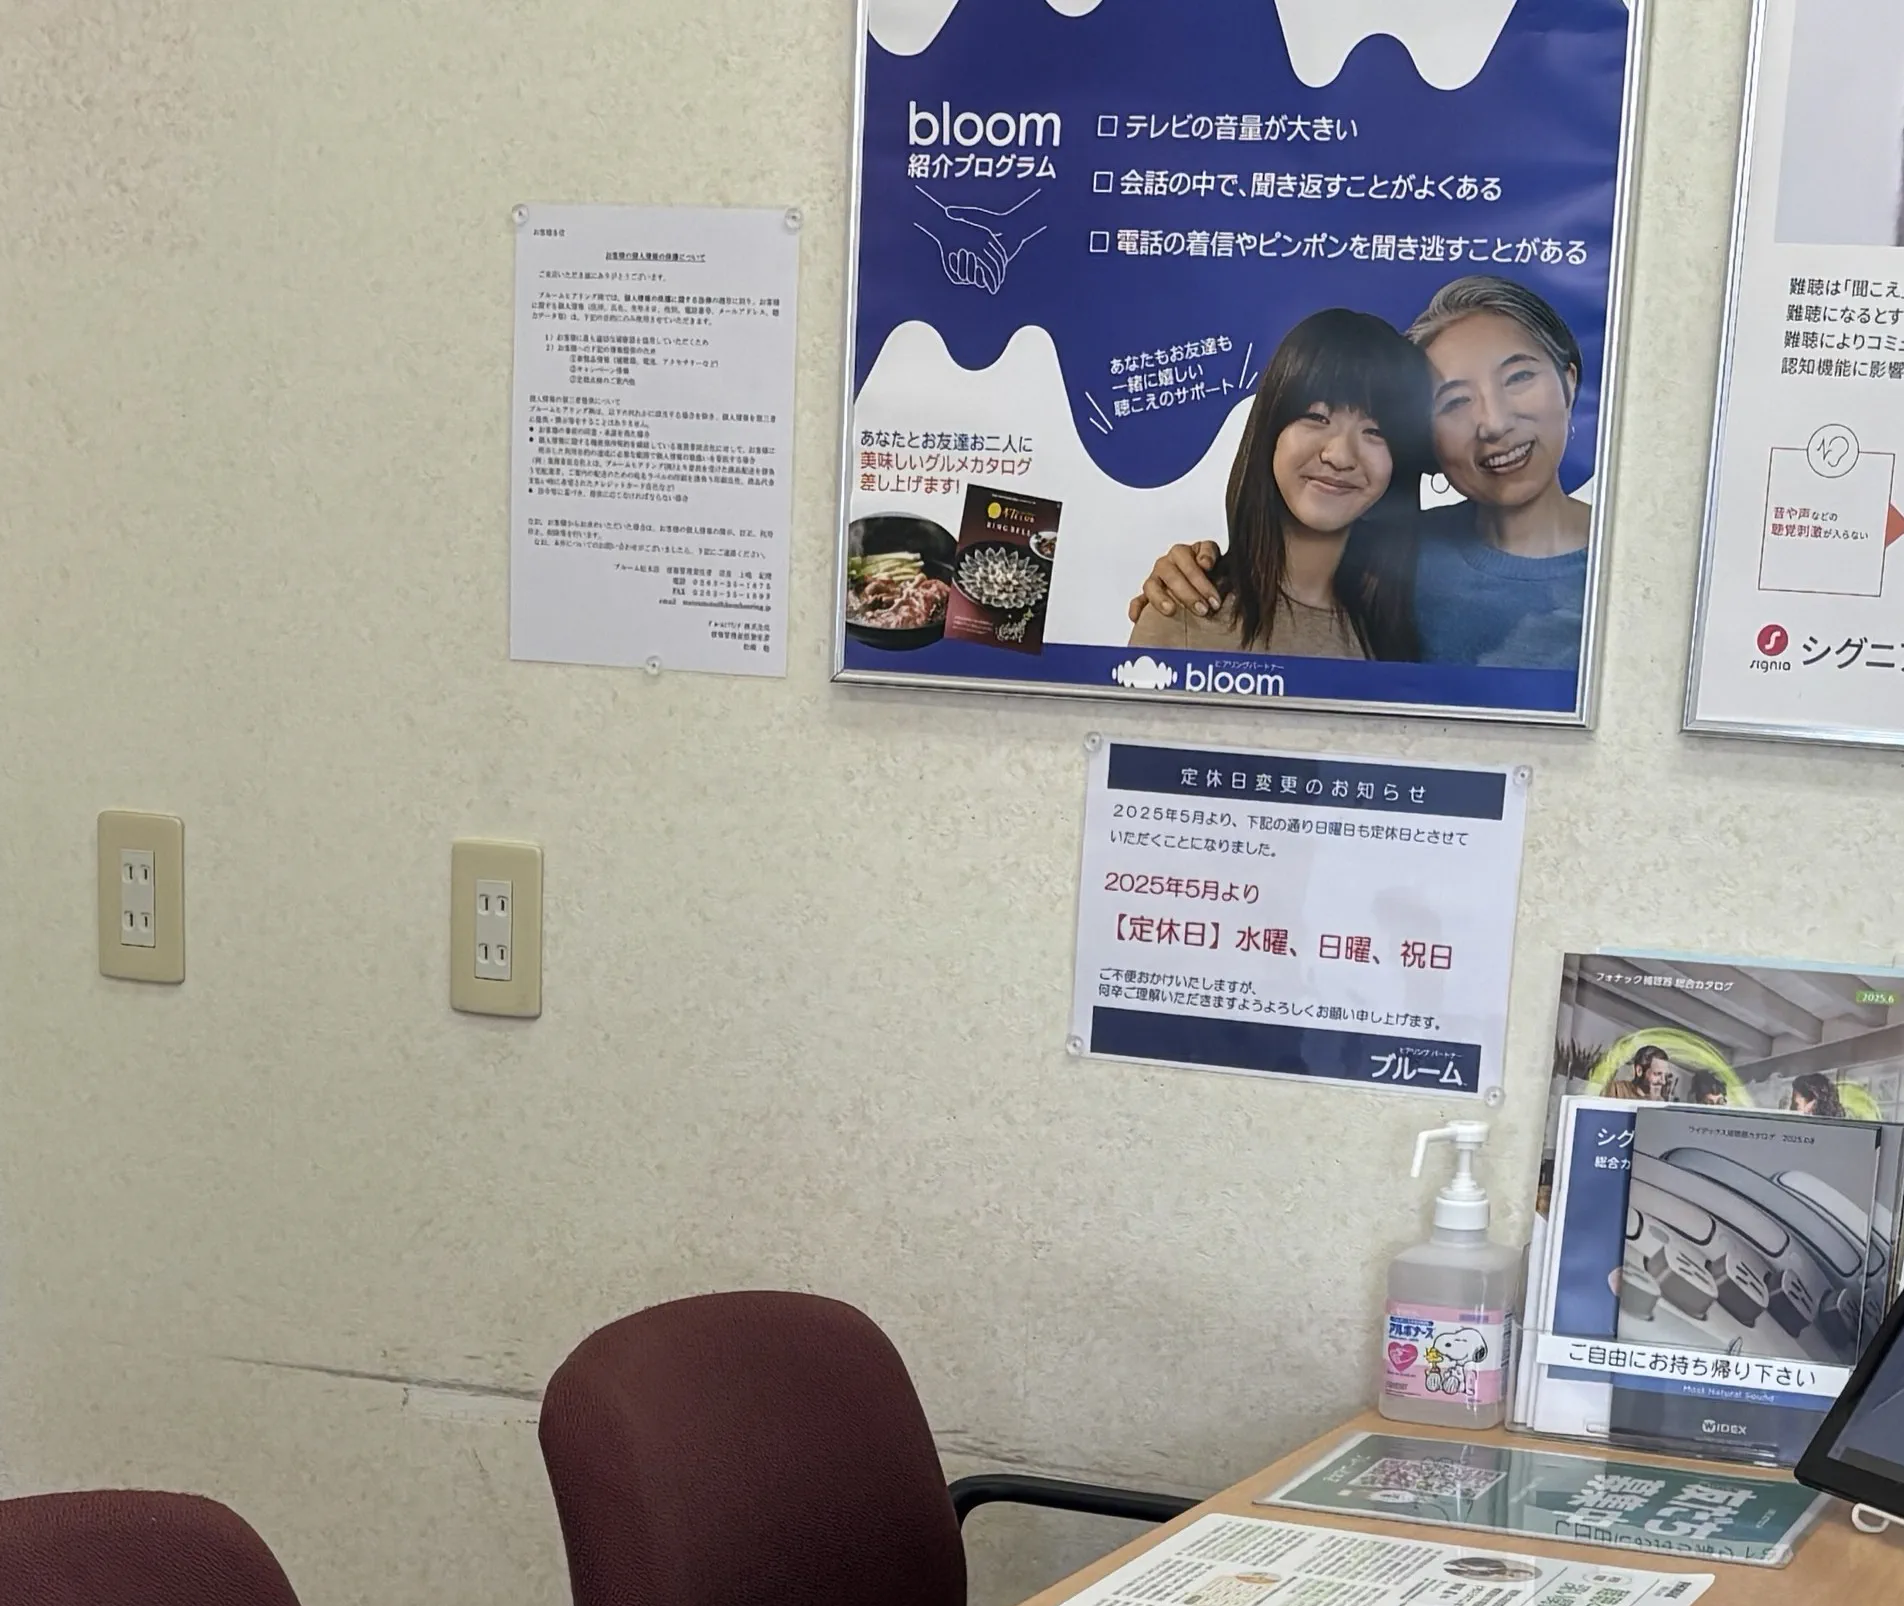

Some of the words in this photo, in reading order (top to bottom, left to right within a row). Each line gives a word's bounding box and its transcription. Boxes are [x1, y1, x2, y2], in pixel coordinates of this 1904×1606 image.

[908, 100, 1062, 150] bloom
[1125, 113, 1359, 143] テレビの音量が大きい
[907, 152, 1057, 180] 紹介プログラム
[1119, 169, 1503, 203] 会話の中で、聞き返すことがよくある
[1116, 229, 1588, 266] 電話の着信やピンポンを聞き逃すことがある
[1109, 335, 1234, 374] あなたもお友達も
[1111, 362, 1205, 396] 一緒に嬉しい
[1113, 376, 1236, 418] 聴こえのサポート
[859, 427, 1033, 454] あなたとお友達お二人に
[859, 449, 1032, 477] 美味しいグルメカタログ
[1773, 506, 1838, 522] 音や声などの
[1771, 523, 1869, 540] 聴覚刺激が入らない
[1185, 662, 1285, 697] bloom
[1749, 659, 1791, 673] signia
[1180, 767, 1427, 805] 定休日変更のお知らせ
[1110, 830, 1277, 858] いただくことになりました。
[1104, 872, 1260, 905] 2025年5月より
[1098, 967, 1257, 997] ご不便おかけいたしますが、
[1675, 978, 1735, 992] 総合カタログ
[1098, 983, 1442, 1032] 何卒ご理解いただきますようよろしくお願い申し上げます。
[1370, 1054, 1464, 1087] ブルーム
[1569, 1342, 1816, 1388] ご自由にお持ち帰り下さい
[1708, 1386, 1742, 1398] Natural
[1702, 1418, 1747, 1435] WIDEX
